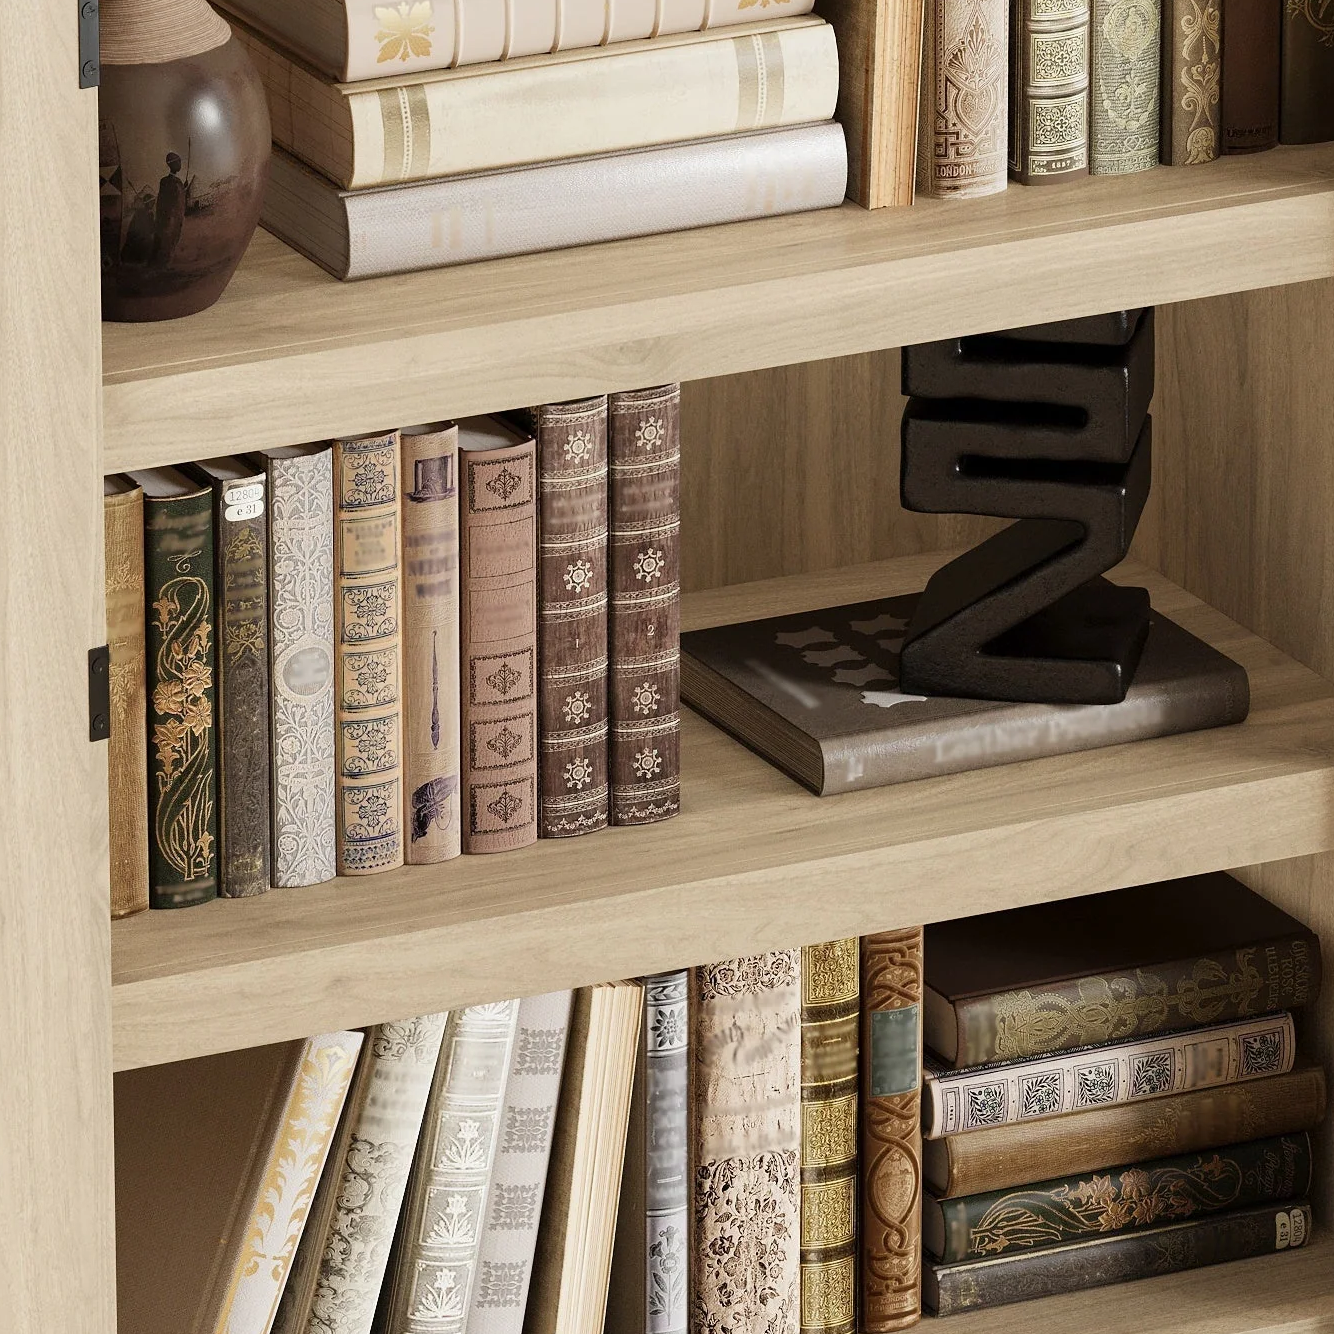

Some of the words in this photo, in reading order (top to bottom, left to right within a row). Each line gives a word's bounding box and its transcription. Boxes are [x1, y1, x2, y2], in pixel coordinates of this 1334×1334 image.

[936, 165, 972, 178] LONDON
[246, 504, 256, 514] 31
[647, 624, 655, 636] 2
